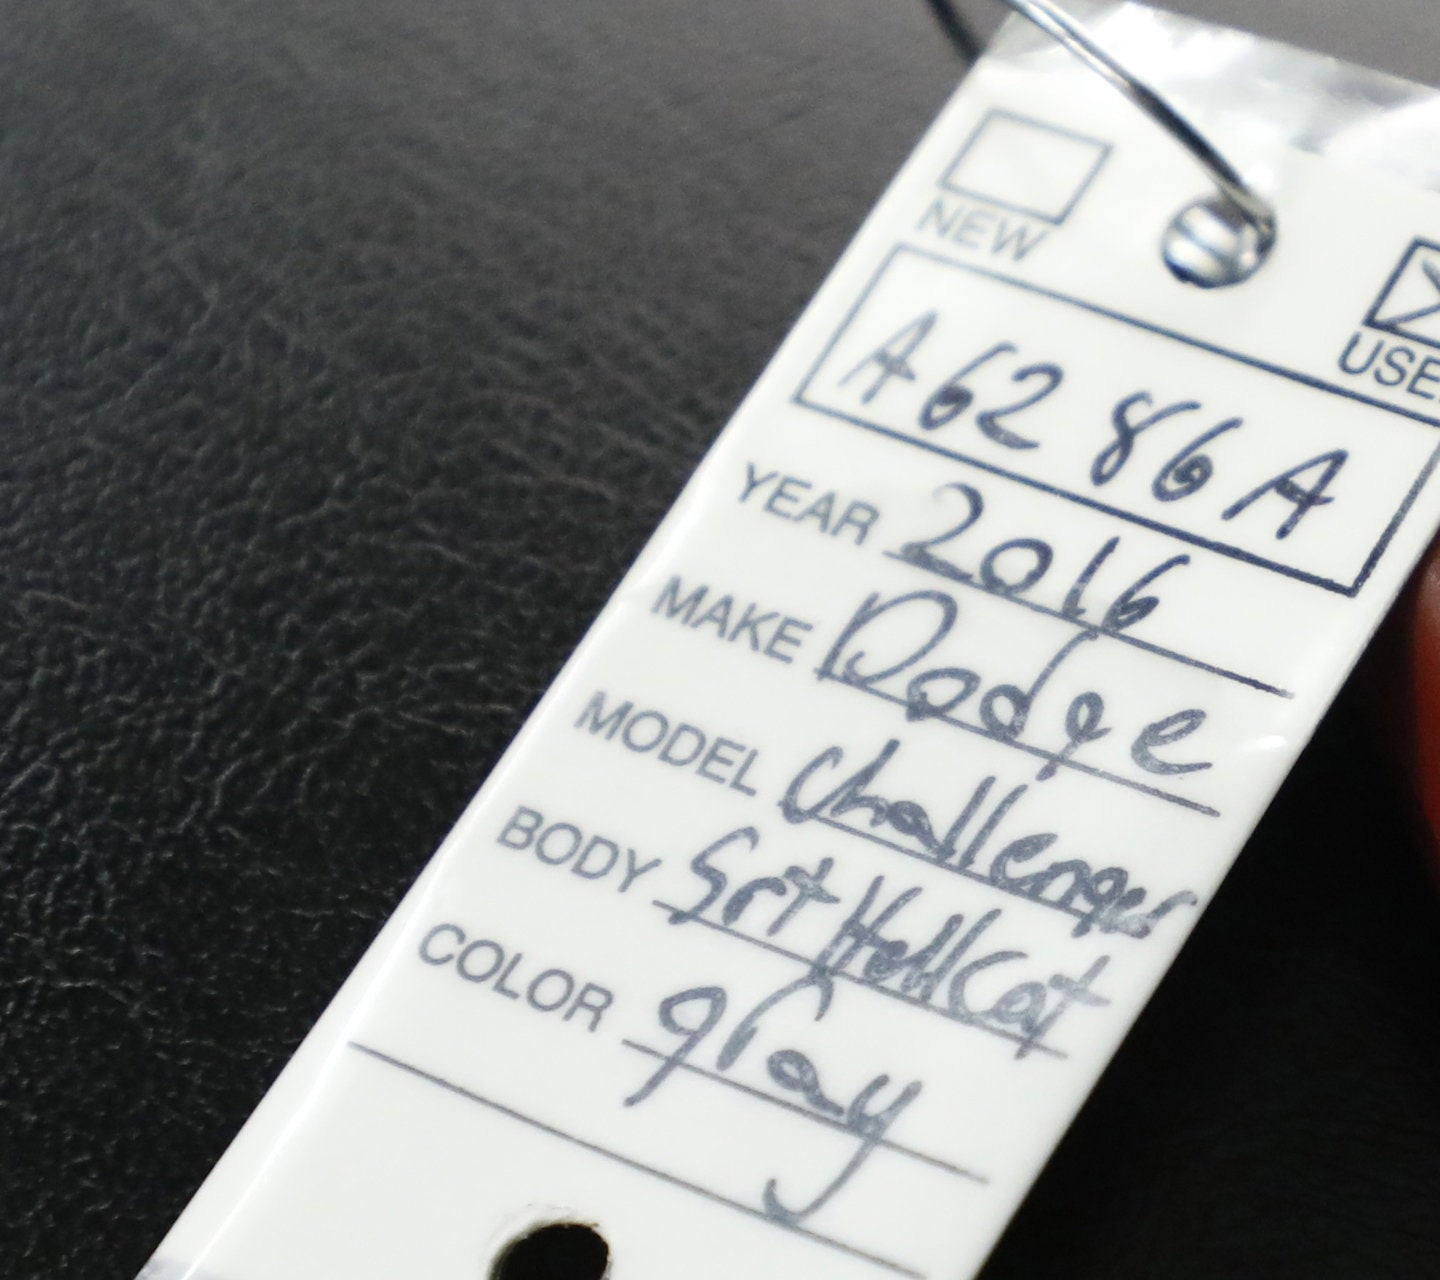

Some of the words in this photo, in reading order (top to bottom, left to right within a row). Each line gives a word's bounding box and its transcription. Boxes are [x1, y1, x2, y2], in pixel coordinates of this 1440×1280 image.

[915, 202, 1049, 263] NEW
[736, 461, 881, 546] YEAR
[895, 482, 1192, 634] 2016
[651, 573, 815, 664] MAKE
[813, 588, 1214, 782] Dodge
[574, 689, 760, 798] MODEL
[497, 805, 663, 894] BODY
[417, 922, 616, 1034] COLOR
